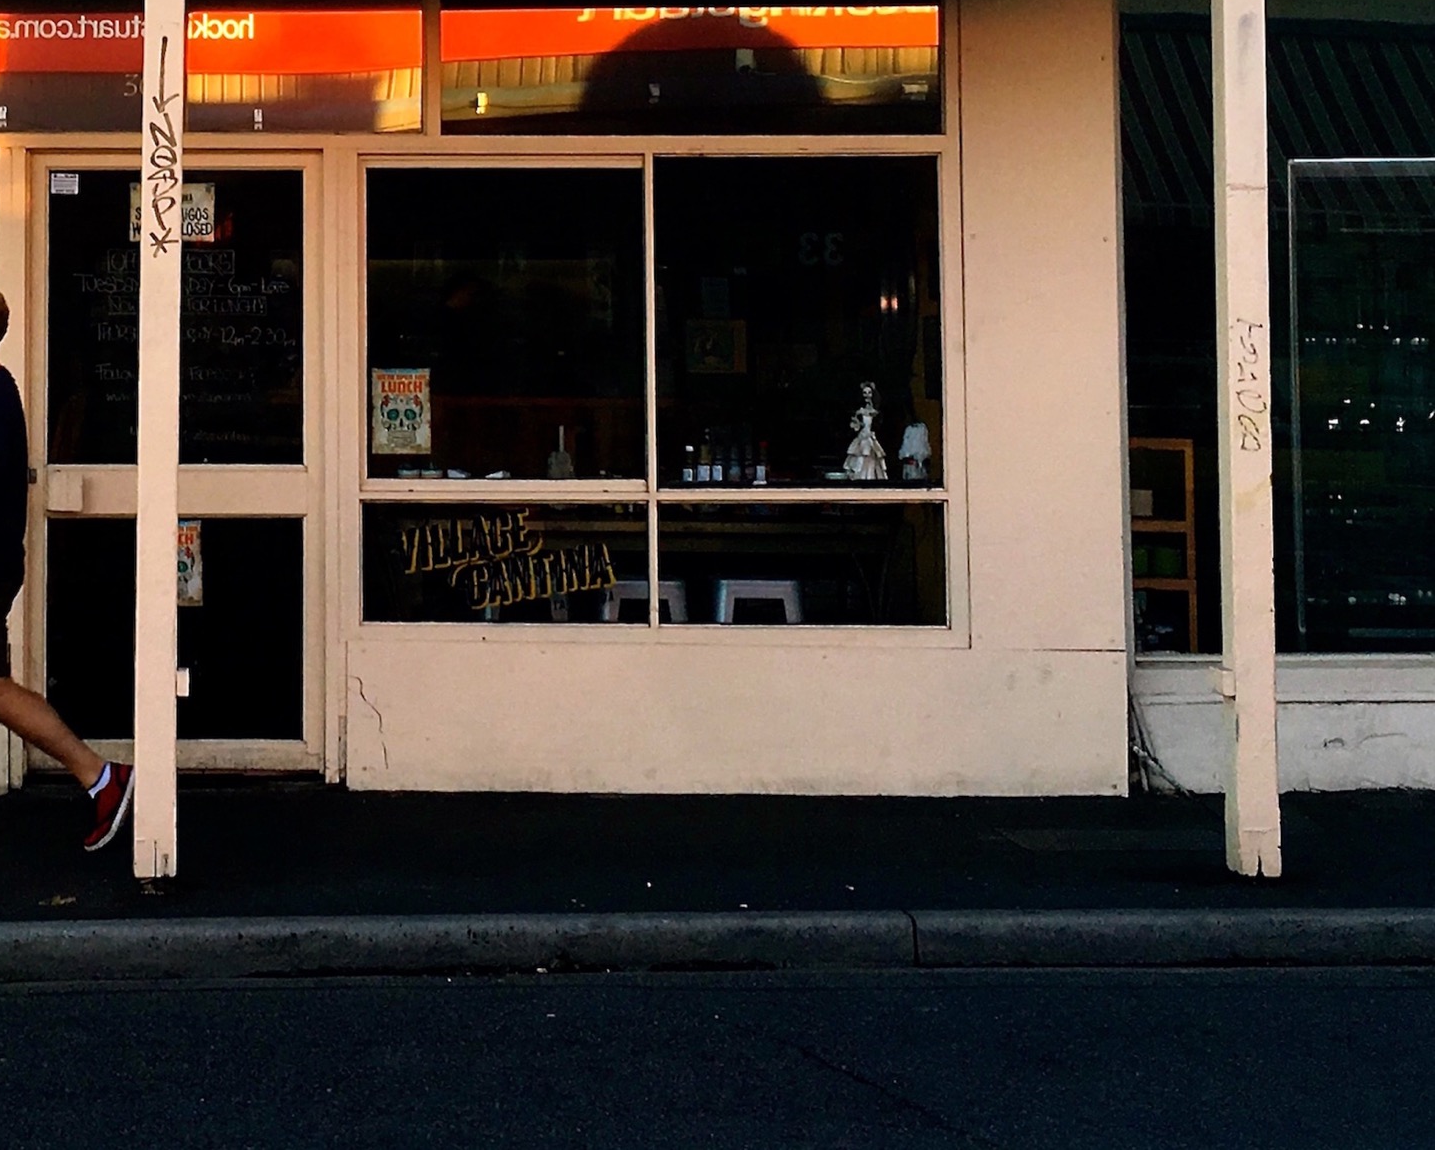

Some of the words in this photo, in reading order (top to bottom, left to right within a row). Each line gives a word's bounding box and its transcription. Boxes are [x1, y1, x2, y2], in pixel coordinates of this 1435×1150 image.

[182, 222, 213, 236] LOSED
[380, 381, 423, 393] LUNCH
[400, 508, 532, 575] VILLAGE
